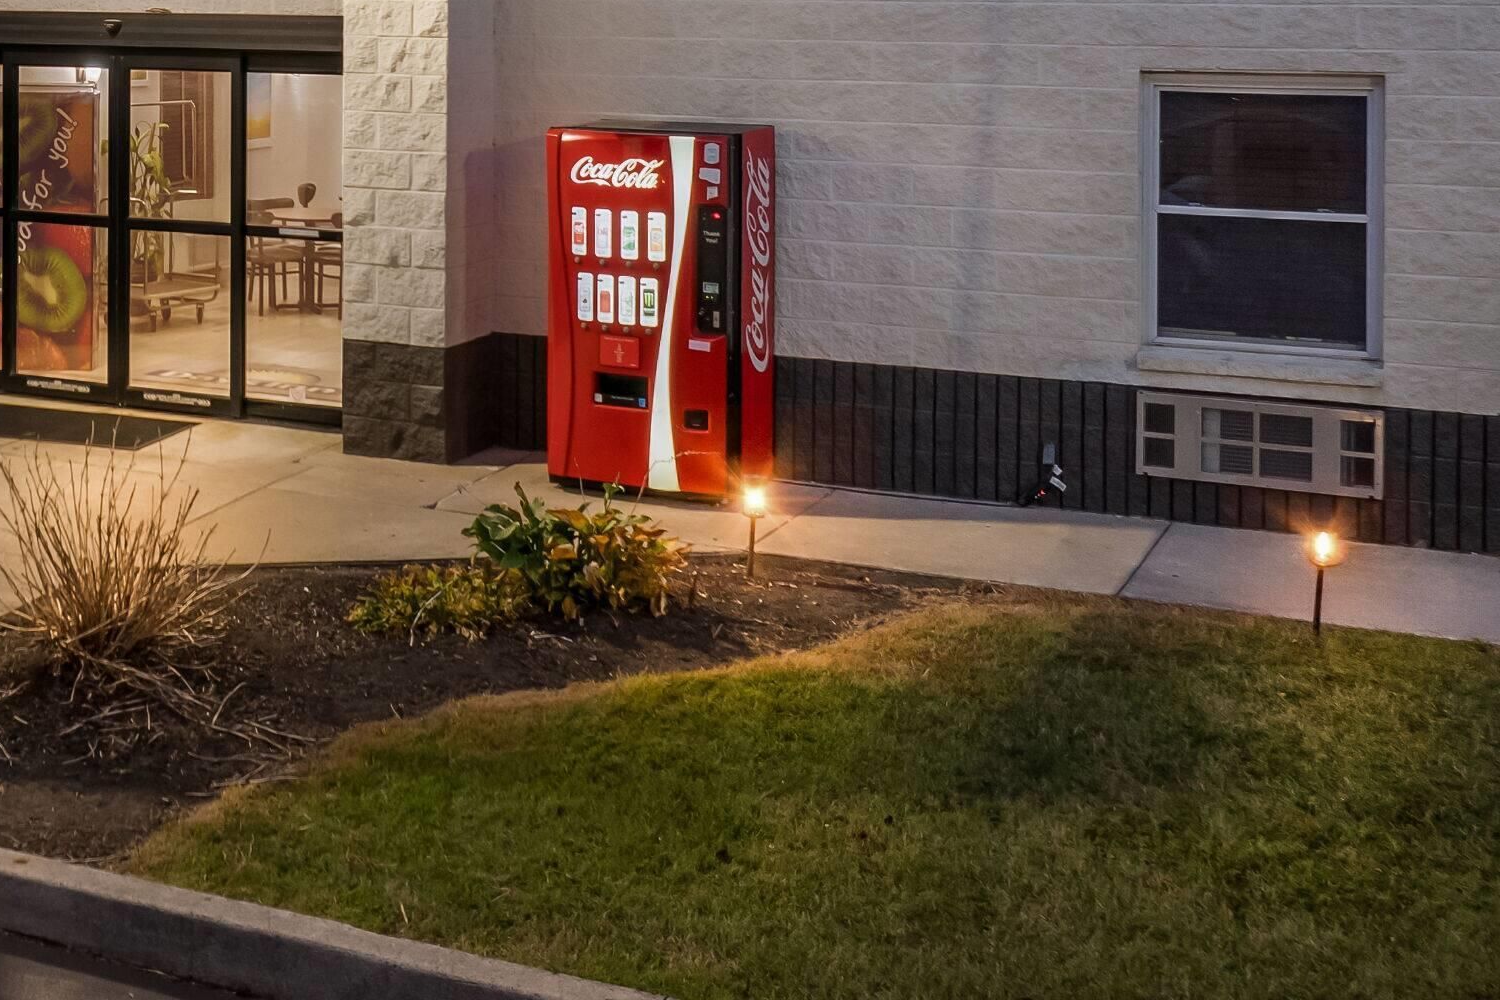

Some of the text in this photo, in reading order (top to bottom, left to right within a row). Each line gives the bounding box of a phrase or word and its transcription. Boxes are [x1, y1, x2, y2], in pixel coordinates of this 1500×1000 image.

[22, 169, 52, 210] for
[48, 107, 78, 169] you!
[570, 156, 664, 189] Coca-Cola
[746, 148, 770, 373] Coca-Cola
